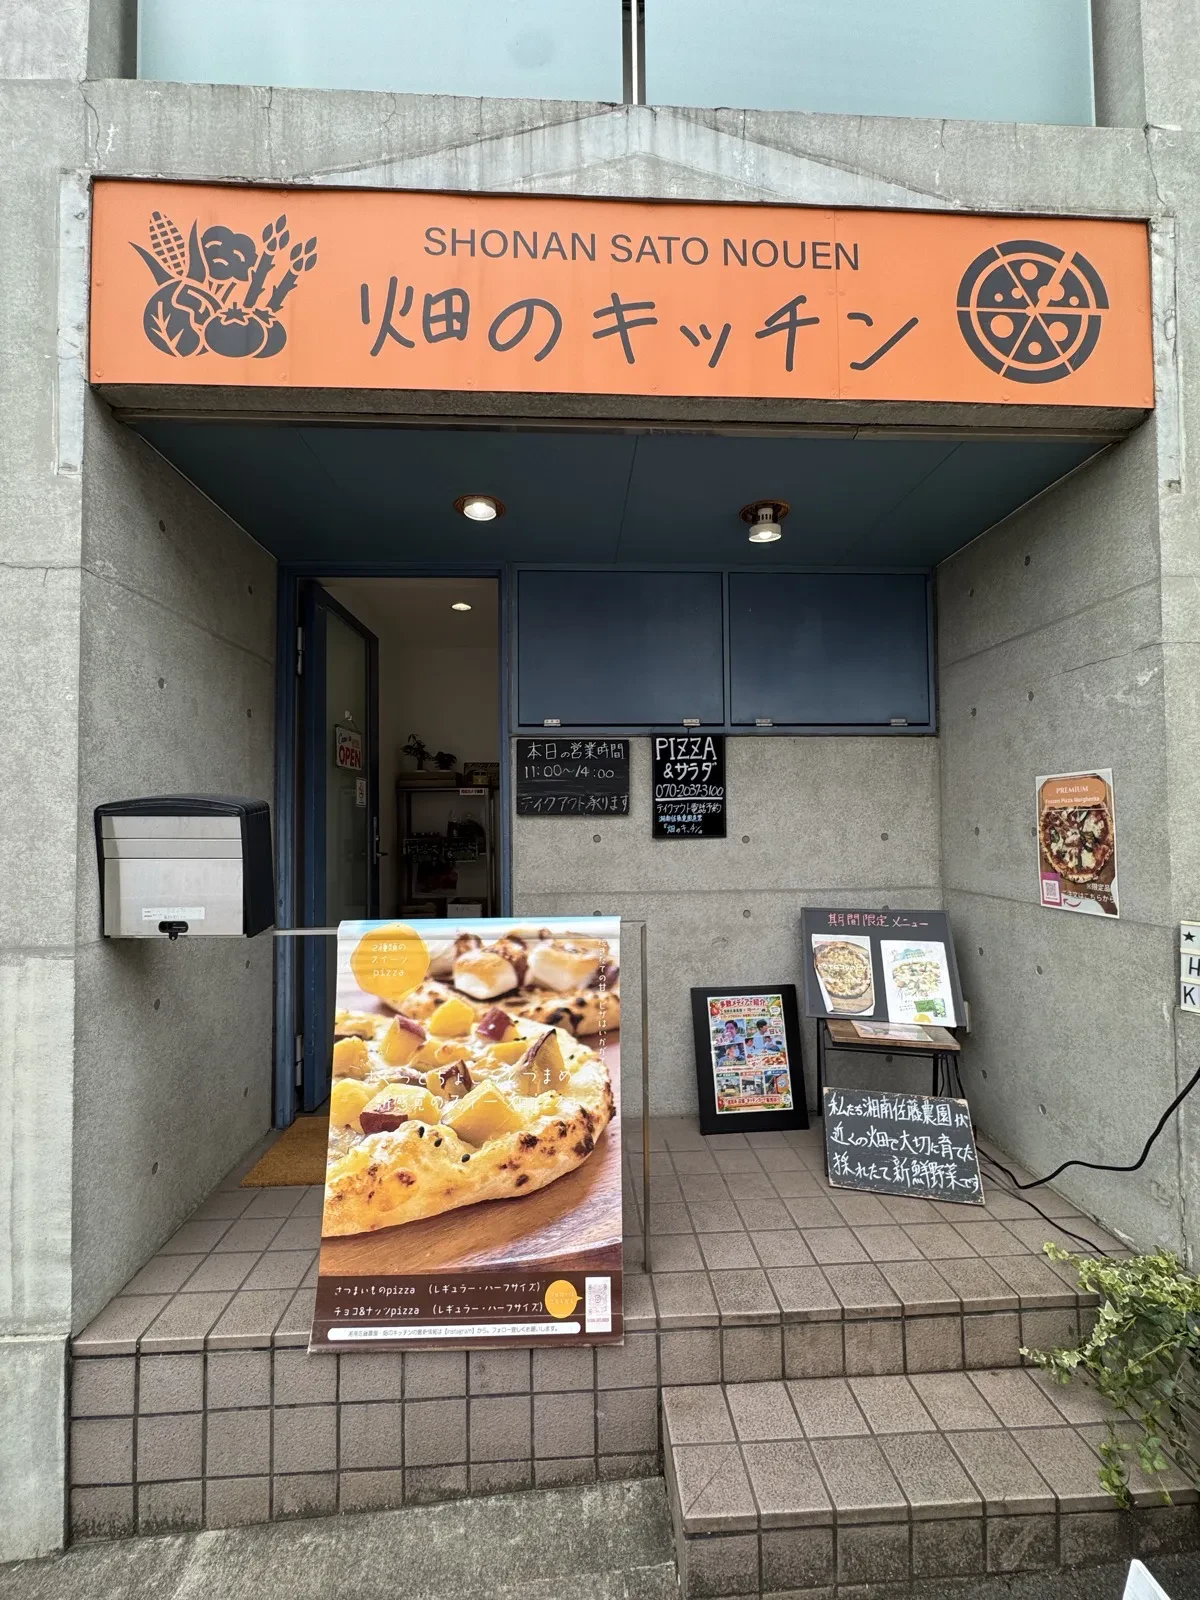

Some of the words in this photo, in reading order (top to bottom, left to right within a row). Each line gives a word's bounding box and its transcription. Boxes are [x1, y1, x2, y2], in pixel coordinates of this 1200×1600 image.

[424, 226, 597, 262] SHONAN
[610, 233, 710, 266] SATO
[723, 238, 860, 271] NOUEN
[361, 275, 919, 372] 畑のキッチン
[338, 745, 361, 769] OPEN
[527, 741, 627, 760] 本日の営業時間
[655, 737, 718, 761] PIZZA
[655, 784, 724, 798] 070-2037-3100
[1055, 785, 1089, 794] PREMIUM
[521, 795, 629, 812] テイクアウト承ります
[371, 943, 407, 953] 2種類の
[371, 955, 408, 965] スイーツ
[373, 968, 405, 978] pizza
[828, 1092, 970, 1128] 私たち湘南佐藤農園が
[830, 1121, 975, 1162] 近くの畑で大切に育てた
[833, 1151, 980, 1194] 採れたて新鮮野菜です
[334, 1285, 416, 1296] さつまいものpizza
